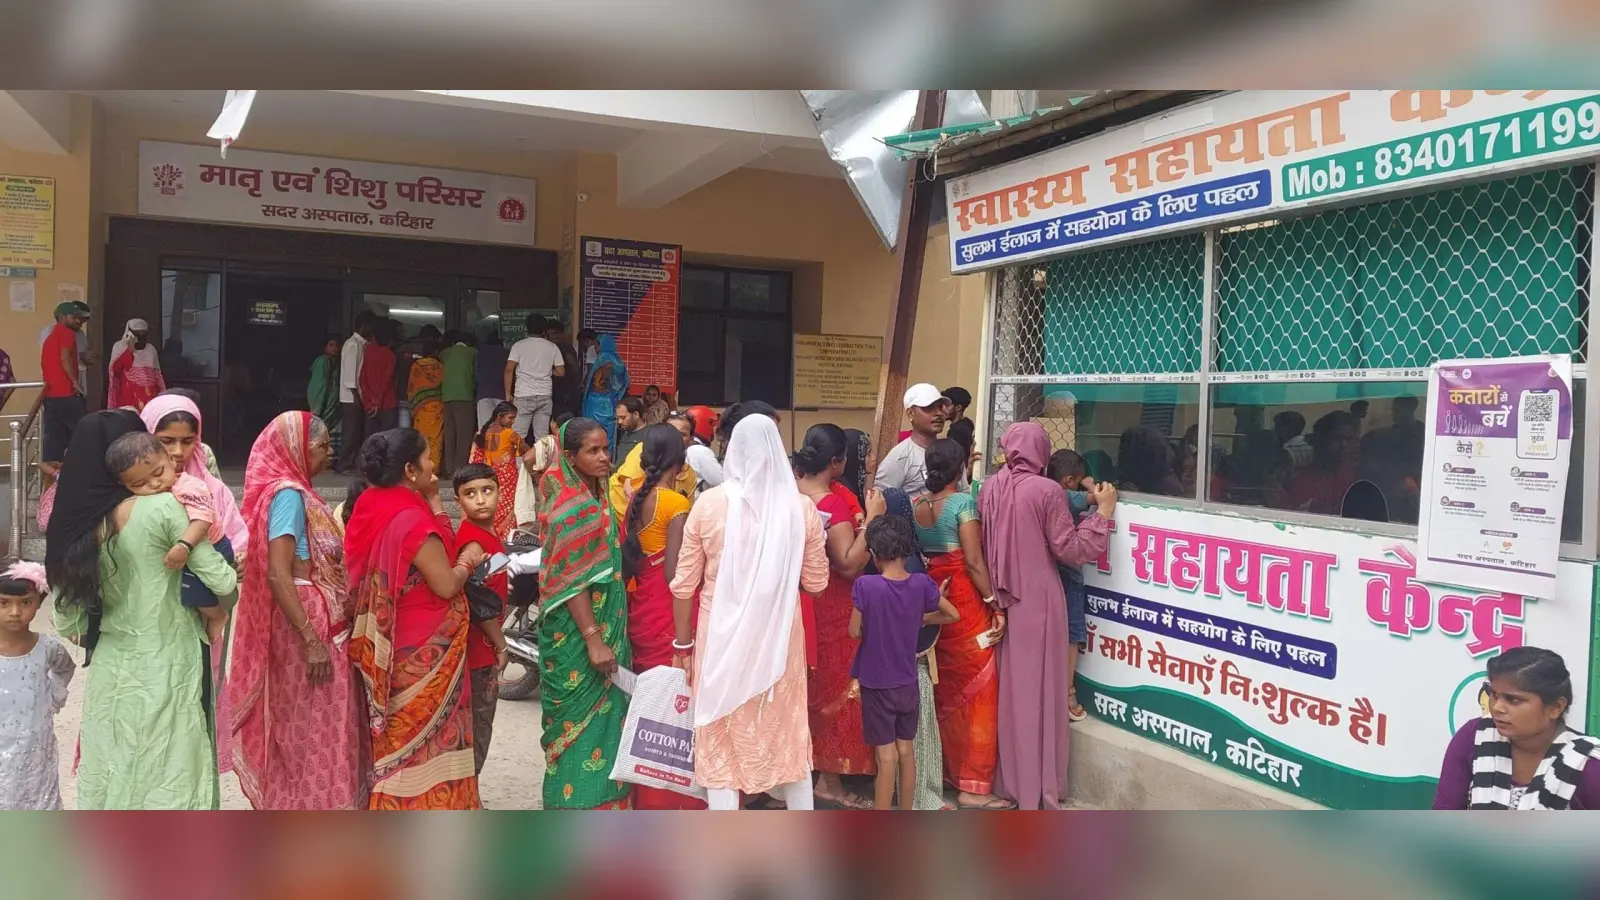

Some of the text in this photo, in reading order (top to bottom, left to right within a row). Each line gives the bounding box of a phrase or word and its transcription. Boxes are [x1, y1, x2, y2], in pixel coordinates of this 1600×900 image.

[953, 92, 1350, 232] स्वास्थ्य सहायता
[1288, 159, 1346, 198] Mob
[1374, 101, 1600, 180] 8340171199
[199, 164, 485, 210] मातृ एवं शिशु परिसर
[261, 204, 435, 229] सदर अस्पताल, कटिहार
[961, 180, 1261, 262] सुलभ ईलाज में सहयोग के लिए पहल
[1448, 384, 1509, 405] कतारों से
[1480, 405, 1513, 428] बचें
[1456, 440, 1473, 454] कैसे
[1129, 522, 1338, 621] सहायता
[1087, 594, 1327, 668] सुलभ ईलाज में सहयोग के लिए पहल
[1099, 634, 1142, 668] सभी
[1148, 641, 1217, 695] सेवाएँ
[638, 728, 679, 749] COTTON
[1093, 692, 1303, 787] सदर अस्पताल, कटिहार
